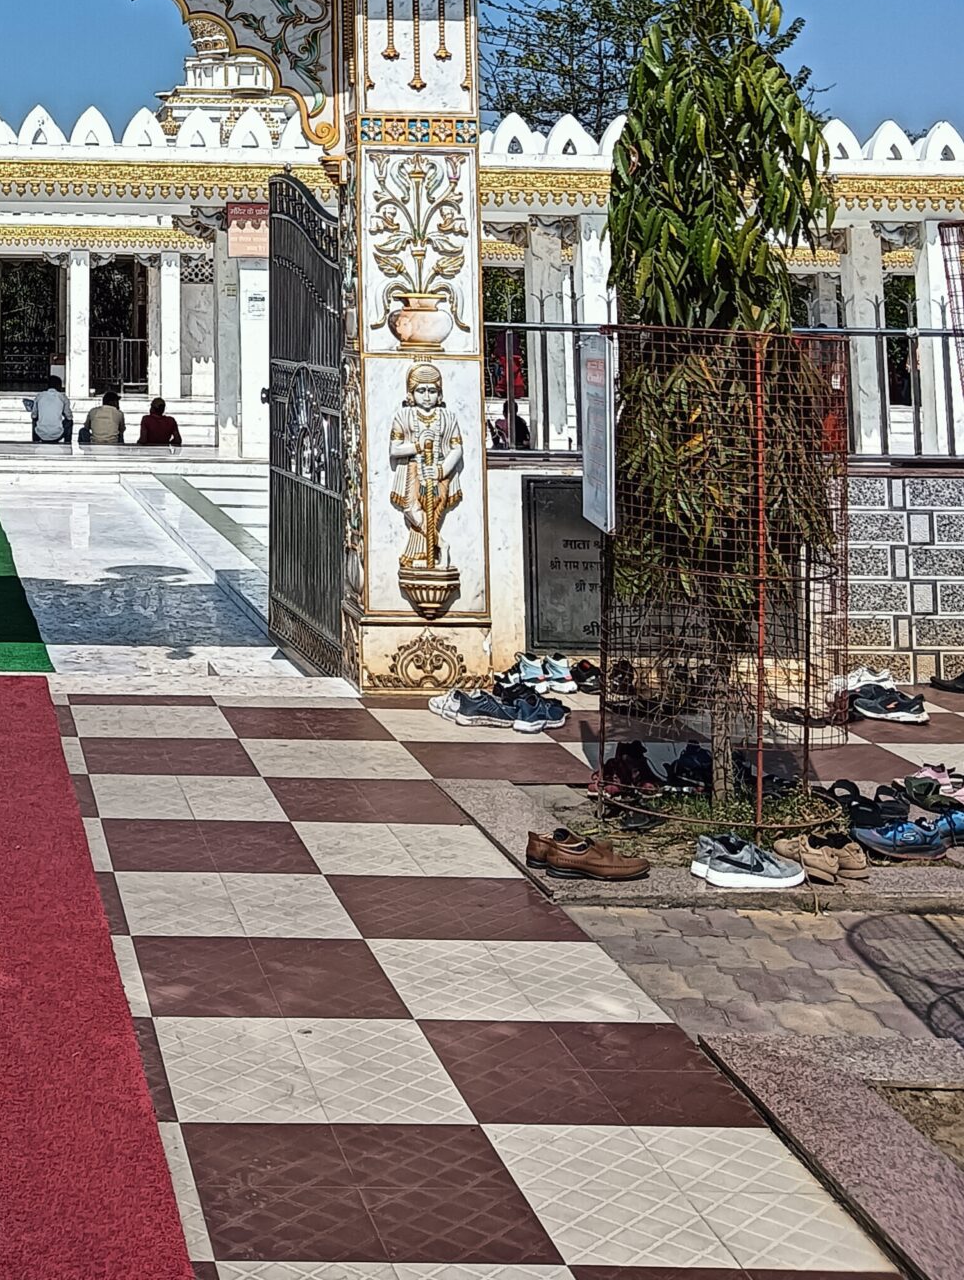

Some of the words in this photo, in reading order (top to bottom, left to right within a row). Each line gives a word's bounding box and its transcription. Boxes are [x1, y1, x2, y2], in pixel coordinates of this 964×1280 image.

[562, 539, 590, 550] माता
[563, 560, 579, 571] राम
[582, 620, 600, 637] श्री
